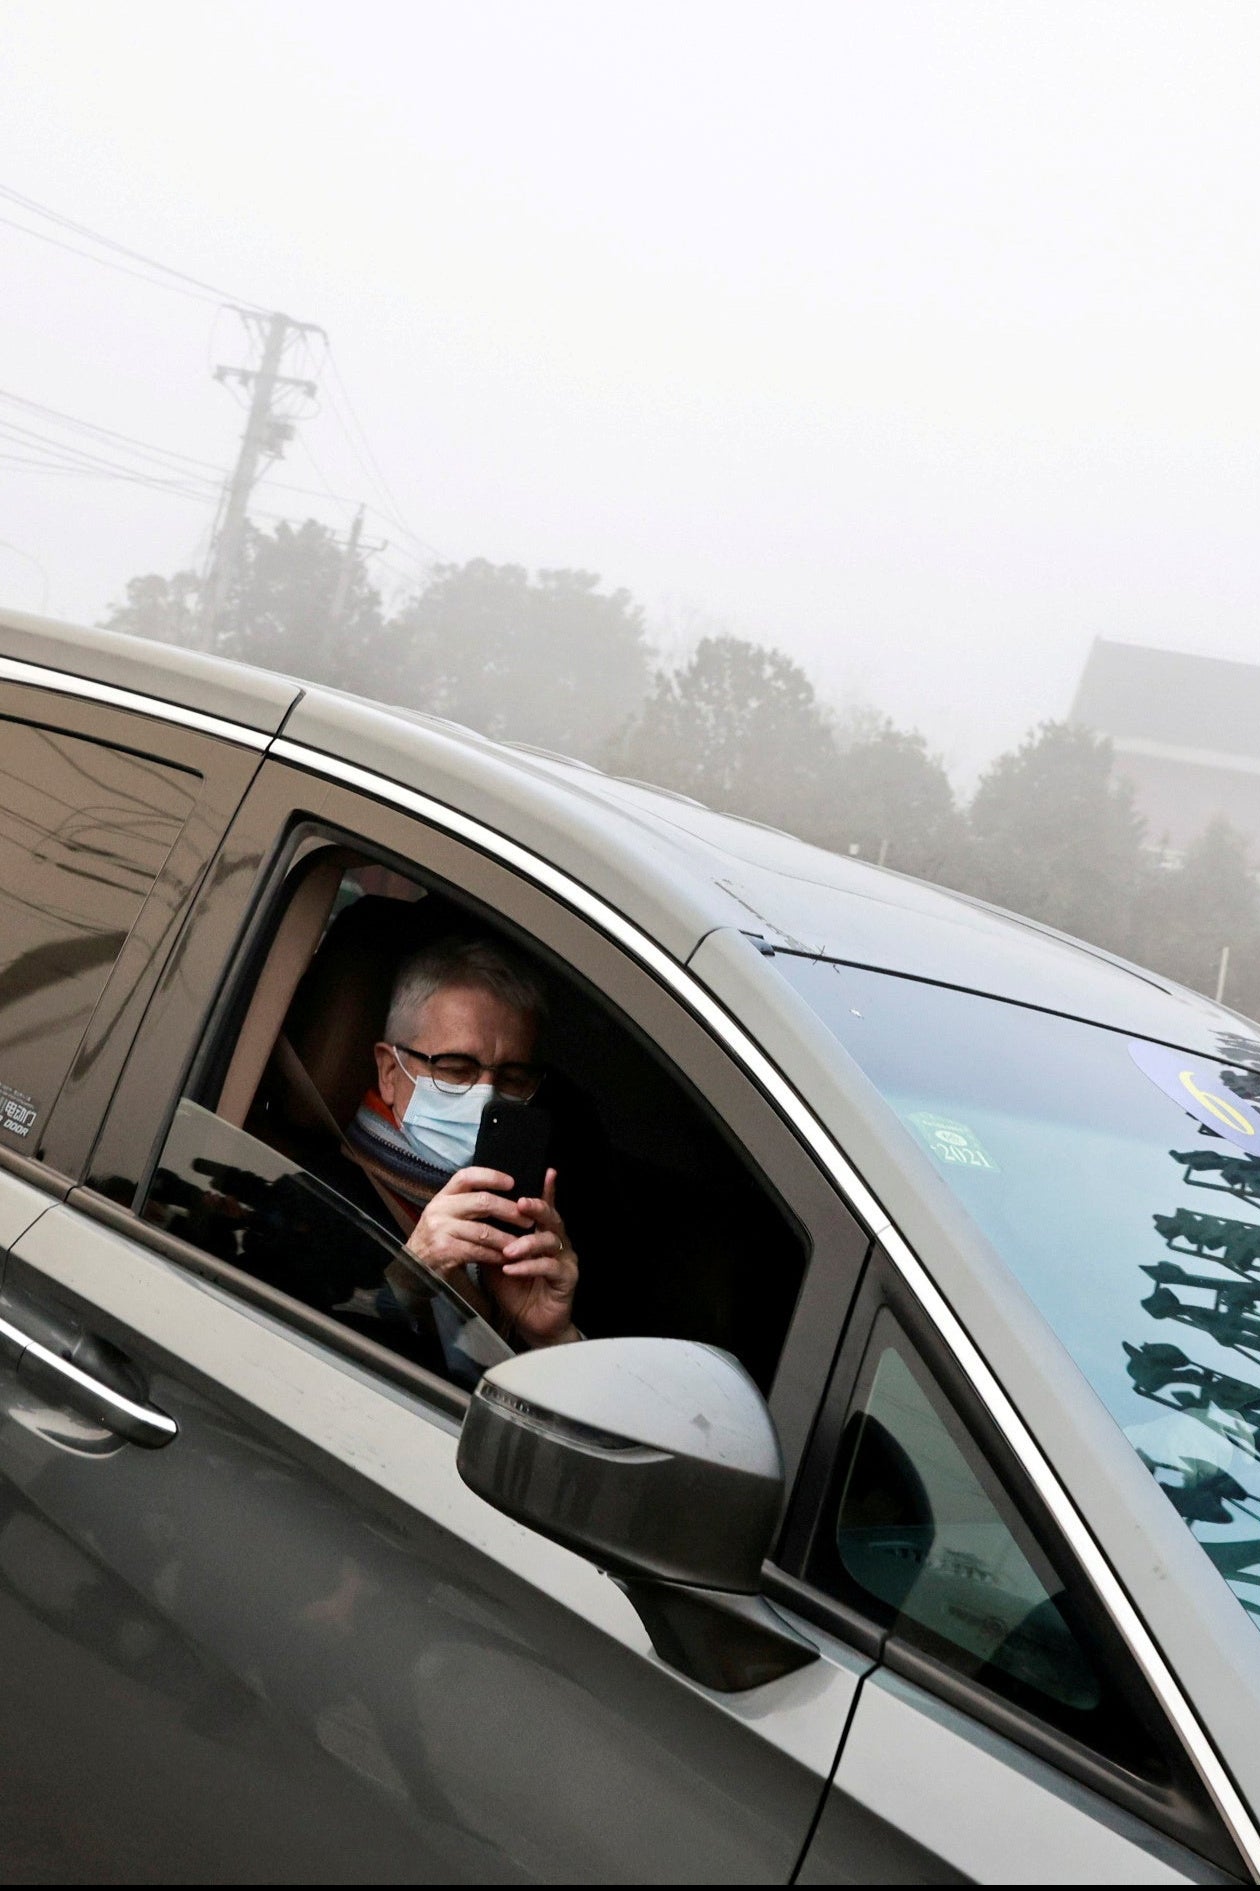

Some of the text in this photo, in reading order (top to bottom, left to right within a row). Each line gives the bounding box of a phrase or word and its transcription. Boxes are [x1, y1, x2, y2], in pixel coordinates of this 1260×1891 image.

[1179, 1071, 1255, 1135] 6
[4, 1119, 29, 1136] DOOR
[934, 1143, 995, 1168] 2021
